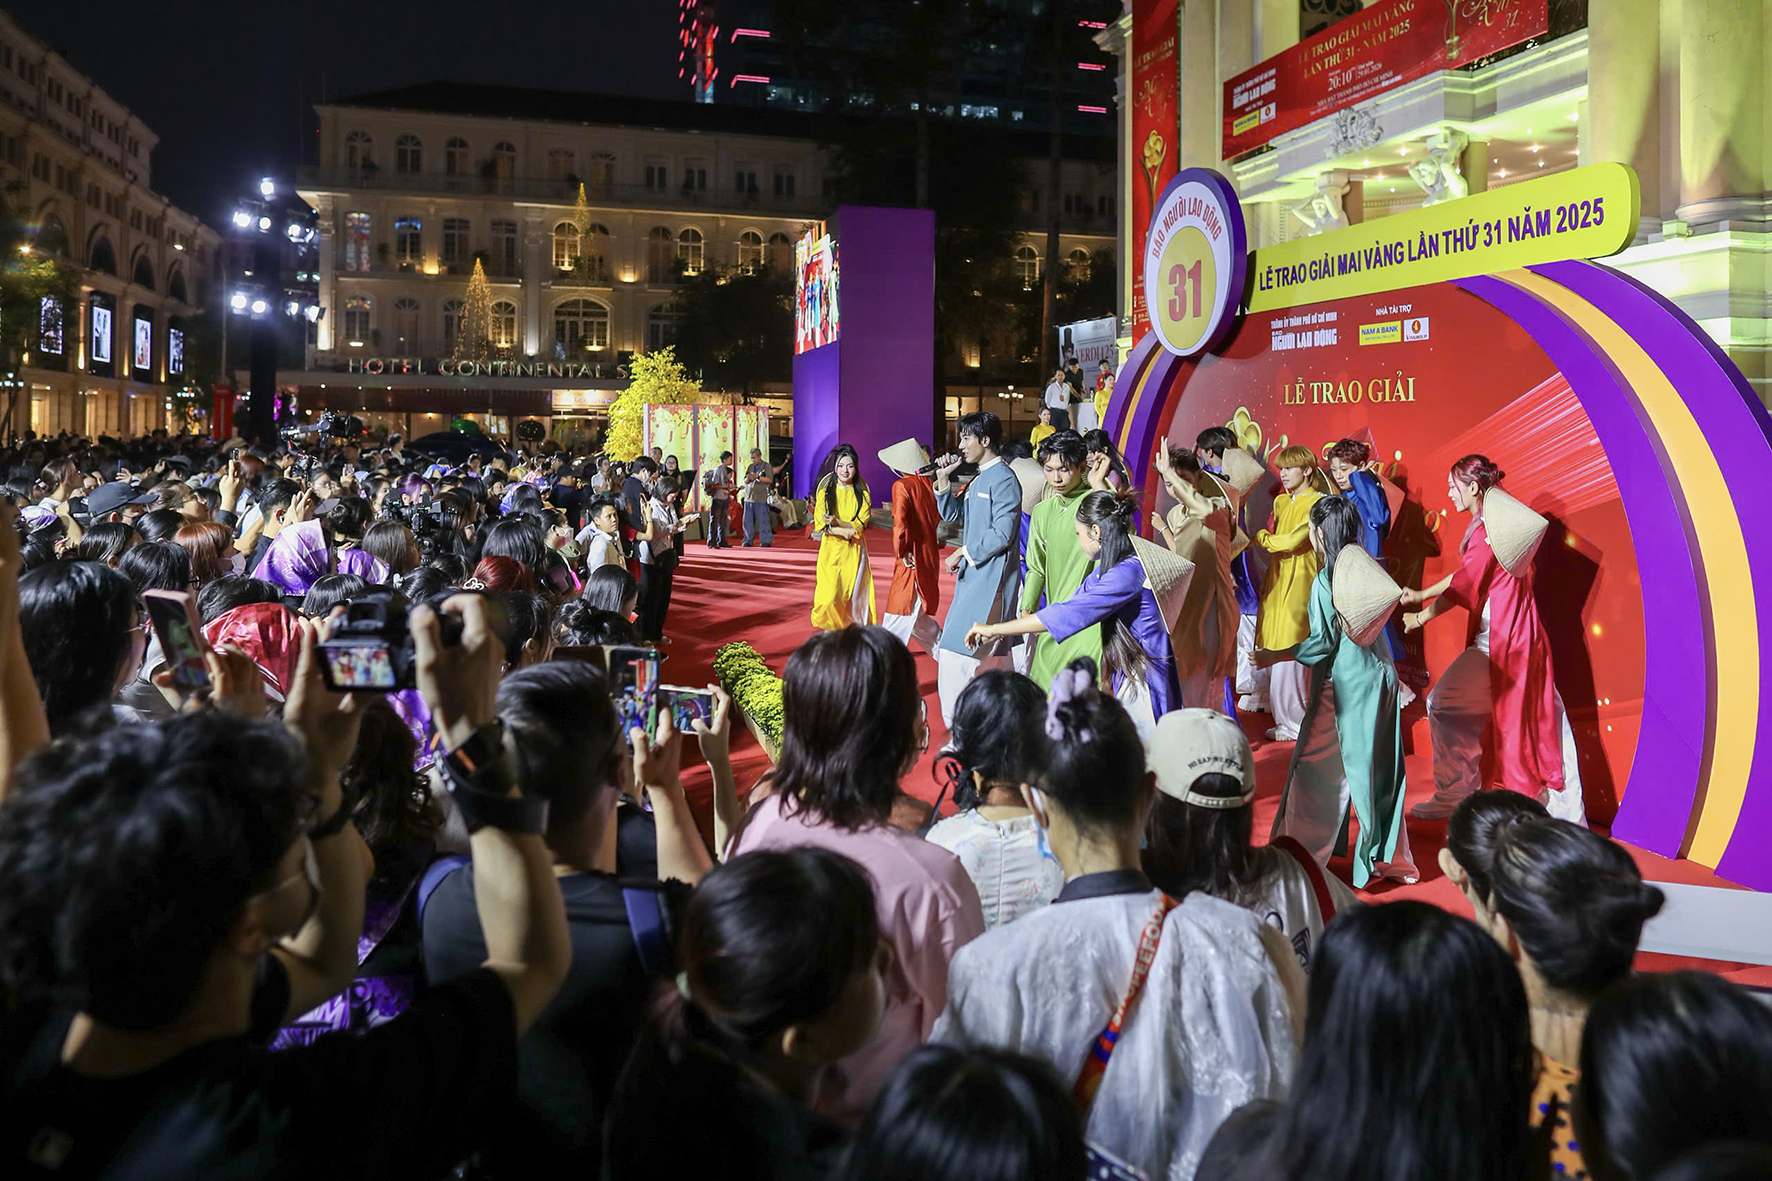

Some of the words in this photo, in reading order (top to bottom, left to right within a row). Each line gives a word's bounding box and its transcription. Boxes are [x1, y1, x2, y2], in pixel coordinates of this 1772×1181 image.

[1312, 36, 1337, 57] TRAO
[1362, 13, 1382, 32] MAI
[1384, 0, 1415, 21] VÀNG
[1502, 9, 1519, 31] 31
[1345, 46, 1355, 60] 31
[1389, 18, 1410, 39] 2025
[1328, 70, 1353, 91] 20:10
[1152, 228, 1165, 260] BÁO
[1163, 196, 1187, 234] NGƯỜI
[1188, 197, 1203, 218] LAO
[1203, 204, 1222, 242] ĐỘNG
[1259, 265, 1273, 291] LỄ
[1275, 262, 1307, 288] TRAO
[1309, 253, 1335, 281] GIẢI
[1338, 250, 1361, 276] MAI
[1364, 240, 1405, 270] VÀNG
[1408, 231, 1439, 262] LẦN
[1442, 218, 1480, 255] THỨ
[1483, 219, 1501, 247] 31
[1508, 206, 1551, 243] NĂM
[1556, 197, 1605, 234] 2025
[1168, 259, 1202, 322] 31
[1375, 305, 1388, 316] NHÀ
[1388, 304, 1399, 314] TÀI
[1398, 303, 1413, 314] TRỢ
[1296, 331, 1313, 348] LAO
[1361, 327, 1376, 336] NAM
[1381, 325, 1399, 334] BANK
[348, 358, 427, 375] HOTEL
[438, 359, 604, 379] CONTINENTAL
[1284, 376, 1306, 405] LỄ
[1310, 379, 1363, 404] TRAO
[1367, 370, 1416, 402] GIẢI
